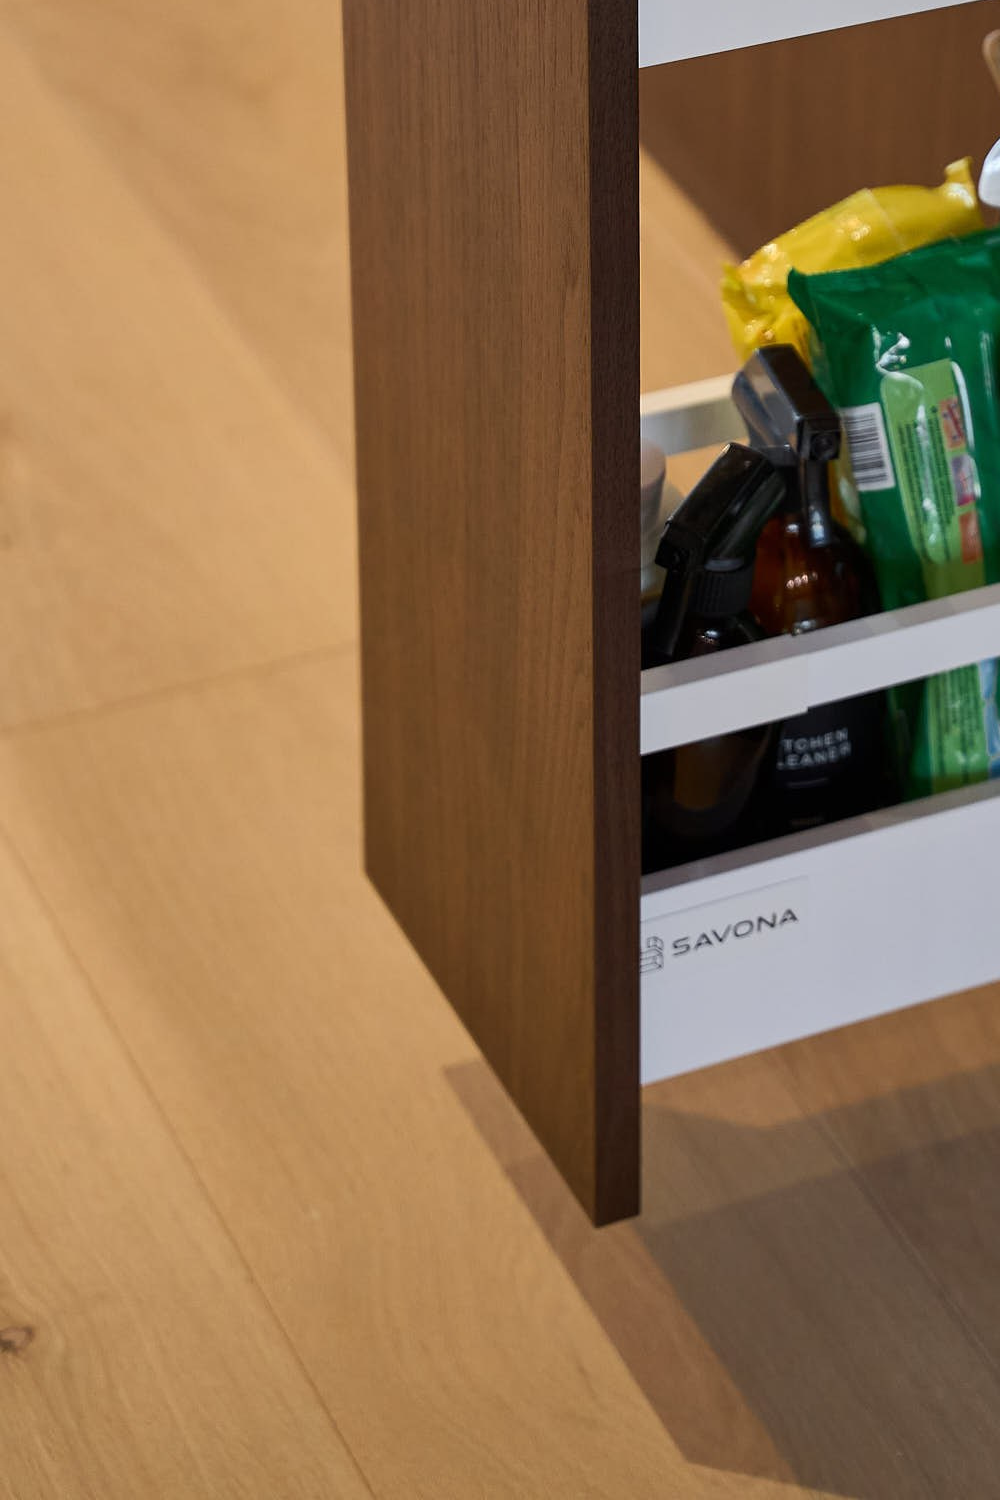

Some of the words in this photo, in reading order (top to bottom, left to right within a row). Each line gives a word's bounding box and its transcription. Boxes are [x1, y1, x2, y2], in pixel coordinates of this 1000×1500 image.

[782, 727, 849, 752] TCHEN
[776, 741, 852, 771] EANER
[672, 908, 798, 957] SAVONA
